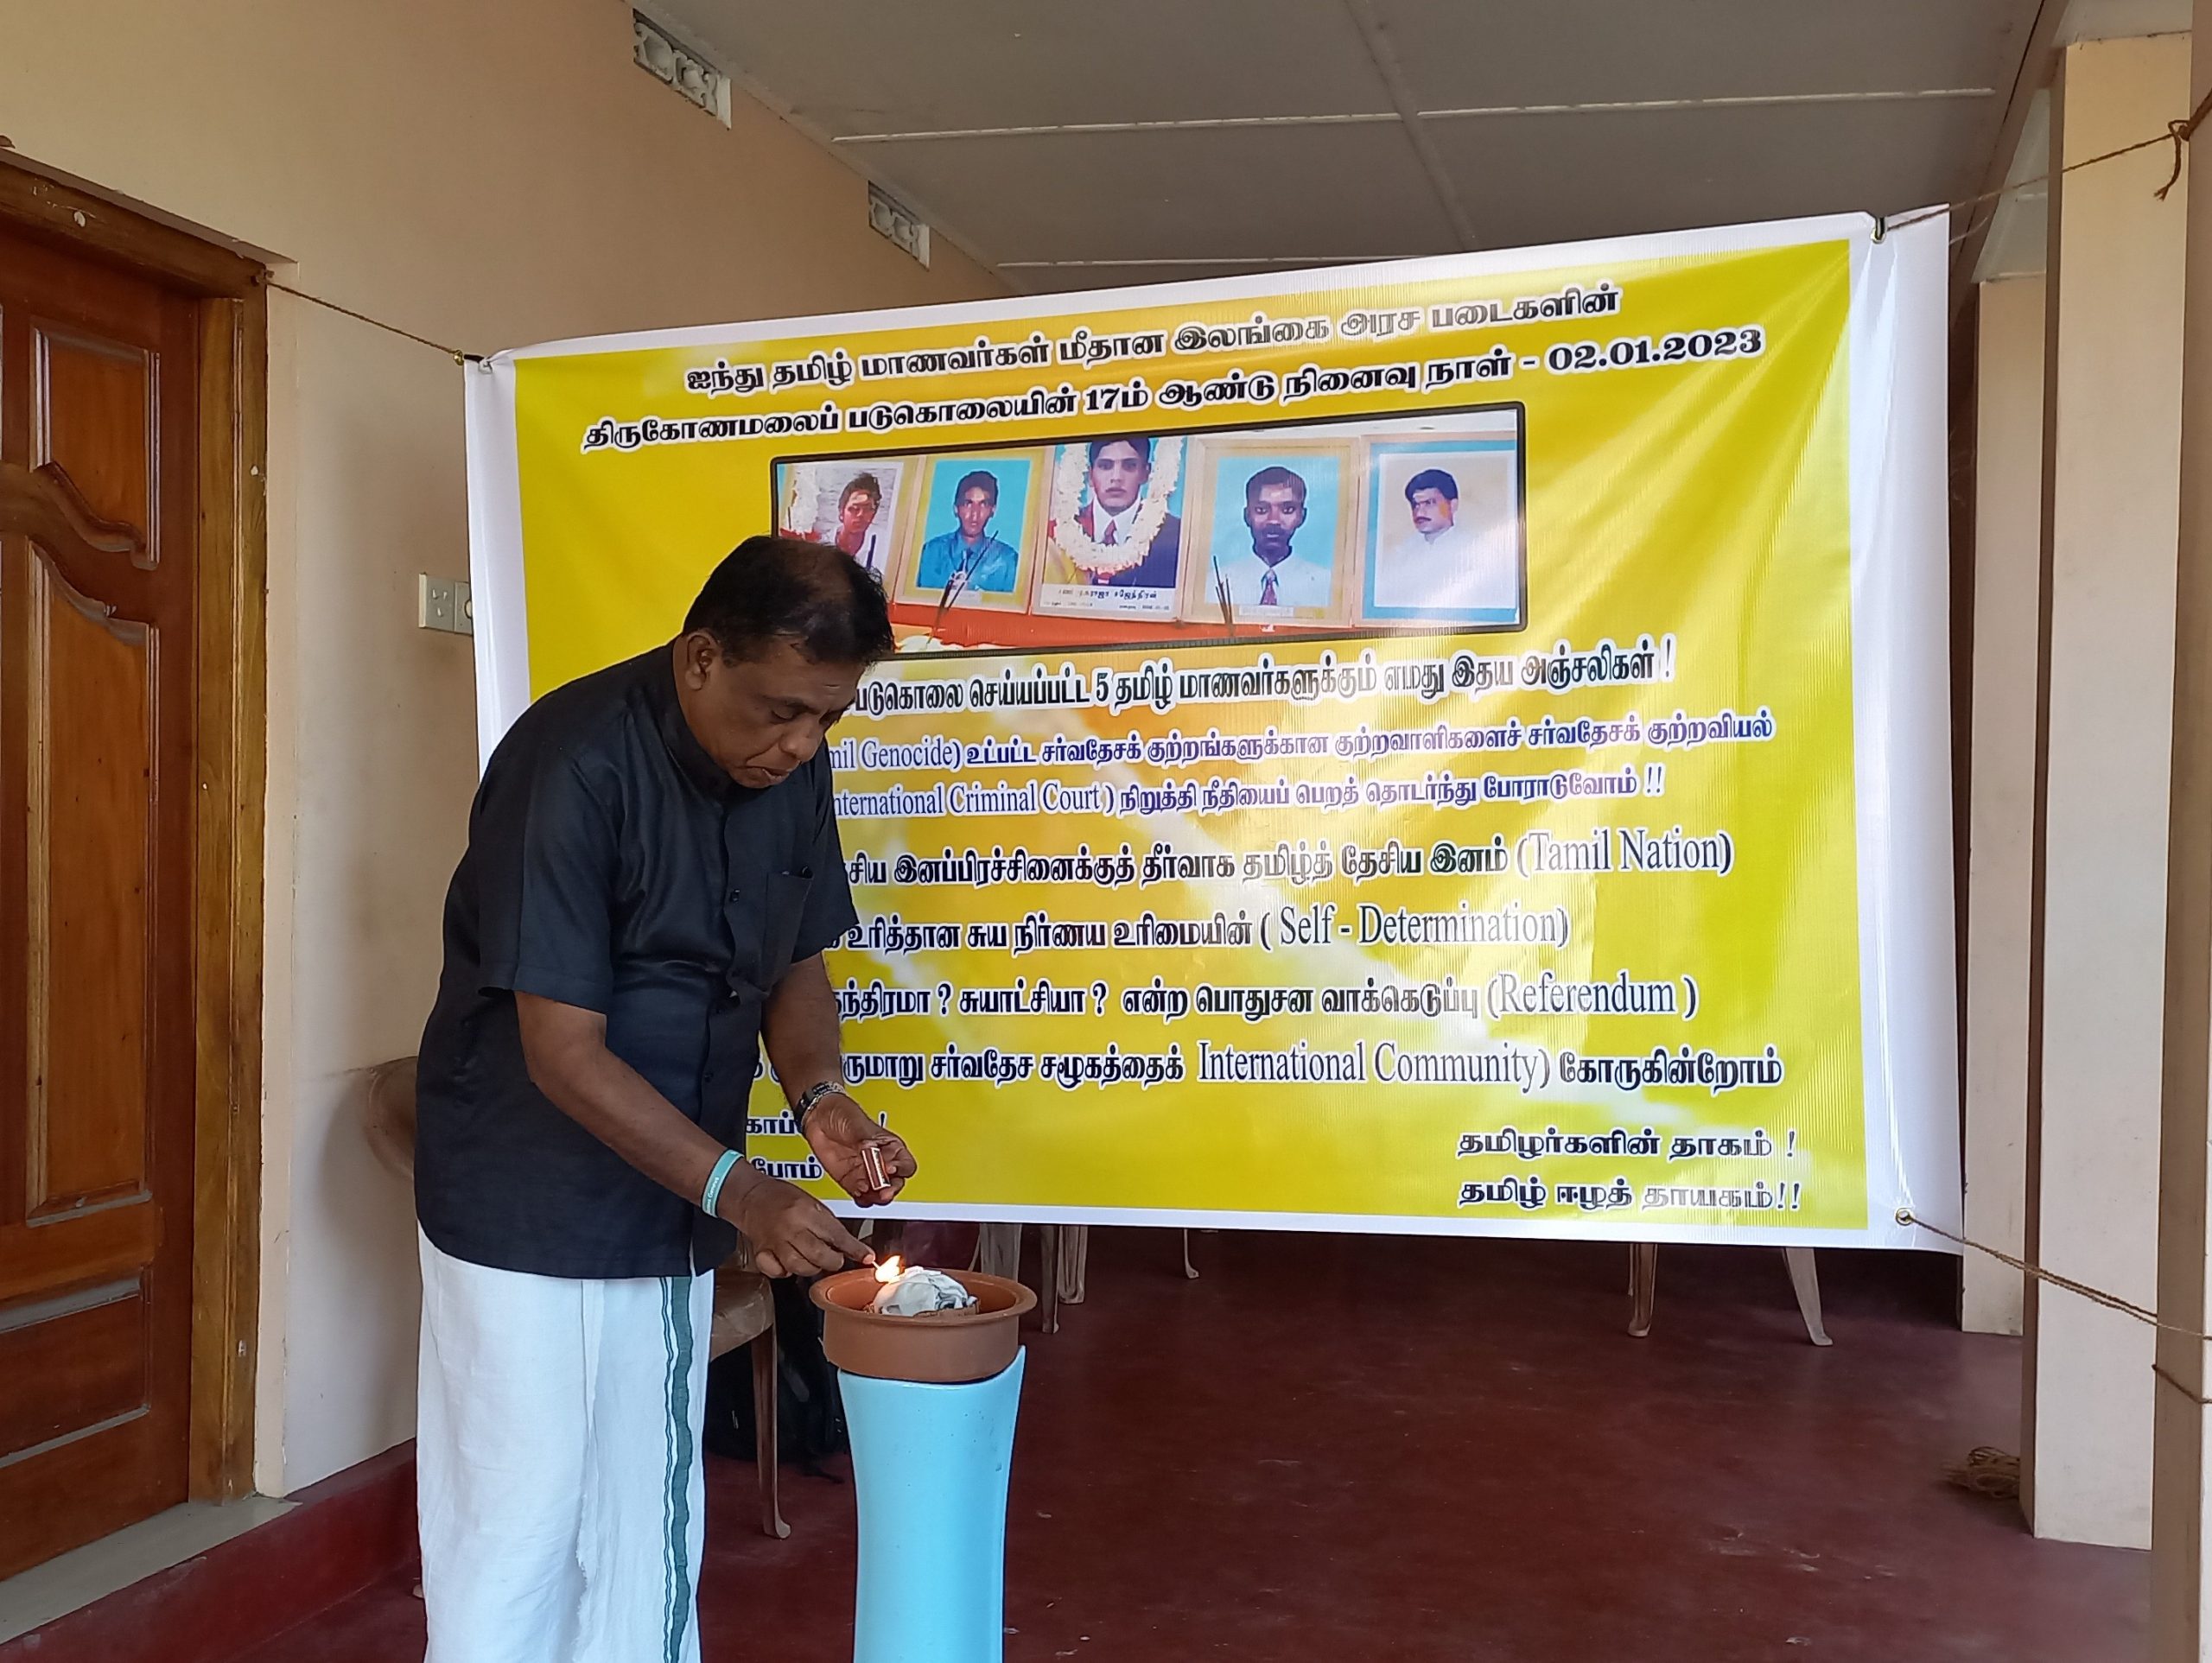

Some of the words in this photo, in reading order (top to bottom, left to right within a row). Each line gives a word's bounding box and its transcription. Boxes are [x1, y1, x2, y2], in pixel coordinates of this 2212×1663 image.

[687, 367, 764, 397] ஐந்து
[772, 352, 852, 390] தமிழ்
[861, 335, 1051, 377] மாணவர்கள்
[1060, 330, 1164, 365] மீதான
[1174, 316, 1329, 350] இலங்கை
[1341, 311, 1420, 337] அரச
[1433, 283, 1618, 327] படைகளின்
[583, 404, 838, 450] திருகோணமலைப்
[849, 386, 1077, 430] படுகொலையின்
[1085, 382, 1148, 411] 17ம்
[1159, 368, 1274, 407] ஆண்டு
[1283, 362, 1415, 402] நினைவு
[1426, 348, 1511, 390] நாள்
[1549, 329, 1761, 371] 02.01.2023
[969, 663, 1090, 708] செய்யப்பட்ட
[1096, 672, 1109, 701] 5
[1115, 659, 1173, 708] தமிழ்
[1180, 654, 1376, 701] மாணவர்களுக்கும்
[1385, 663, 1445, 699] எமது
[1452, 656, 1512, 693] இதய
[1522, 639, 1655, 689] அஞ்சலிகள்
[861, 733, 960, 769] Genocide)
[967, 734, 1037, 765] உட்பட்ட
[1039, 733, 1146, 767] சர்வதேசக்
[1146, 730, 1328, 765] குற்றங்களுக்கான
[1336, 720, 1522, 757] குற்றவாளிகளைச்
[1529, 715, 1640, 748] சர்வதேசக்
[1648, 710, 1772, 746] குற்றவியல்
[950, 778, 1036, 813] Criminal
[1120, 782, 1198, 815] நிறுத்தி
[1202, 779, 1289, 813] நீதியைப்
[1296, 777, 1358, 809] பெறத்
[1367, 774, 1476, 806] தொடர்ந்து
[1484, 767, 1637, 800] போராடுவோம்
[894, 843, 1135, 890] இனப்பிரச்சினைக்குத்
[1141, 843, 1235, 886] தீர்வாக
[1243, 841, 1332, 885] தமிழ்த்
[1342, 841, 1421, 882] தேசிய
[1430, 836, 1507, 873] இனம்
[1517, 829, 1611, 873] (Tamil
[1619, 828, 1731, 874] Nation)
[849, 914, 960, 955] உரித்தான
[968, 925, 1007, 947] சுய
[1014, 911, 1105, 958] நிர்ணய
[1114, 911, 1252, 946] உரிமையின்
[1281, 904, 1335, 944] Self
[1359, 903, 1567, 947] Determination)
[960, 974, 1088, 1017] சுயாட்சியா
[1123, 978, 1187, 1022] என்ற
[1196, 986, 1313, 1021] பொதுசன
[1322, 977, 1477, 1019] வாக்கெடுப்பு
[841, 1055, 923, 1087] ருமாறு
[931, 1044, 1033, 1089] சர்வதேச
[1199, 1042, 1365, 1084] International
[1376, 1043, 1550, 1094] Community)
[1560, 1047, 1782, 1094] கோருகின்றோம்
[746, 1110, 803, 1134] காப்
[1458, 1127, 1660, 1159] தமிழர்களின்
[1669, 1130, 1771, 1160] தாகம்
[1459, 1177, 1546, 1209] தமிழ்
[1557, 1178, 1632, 1210] ஈழத்
